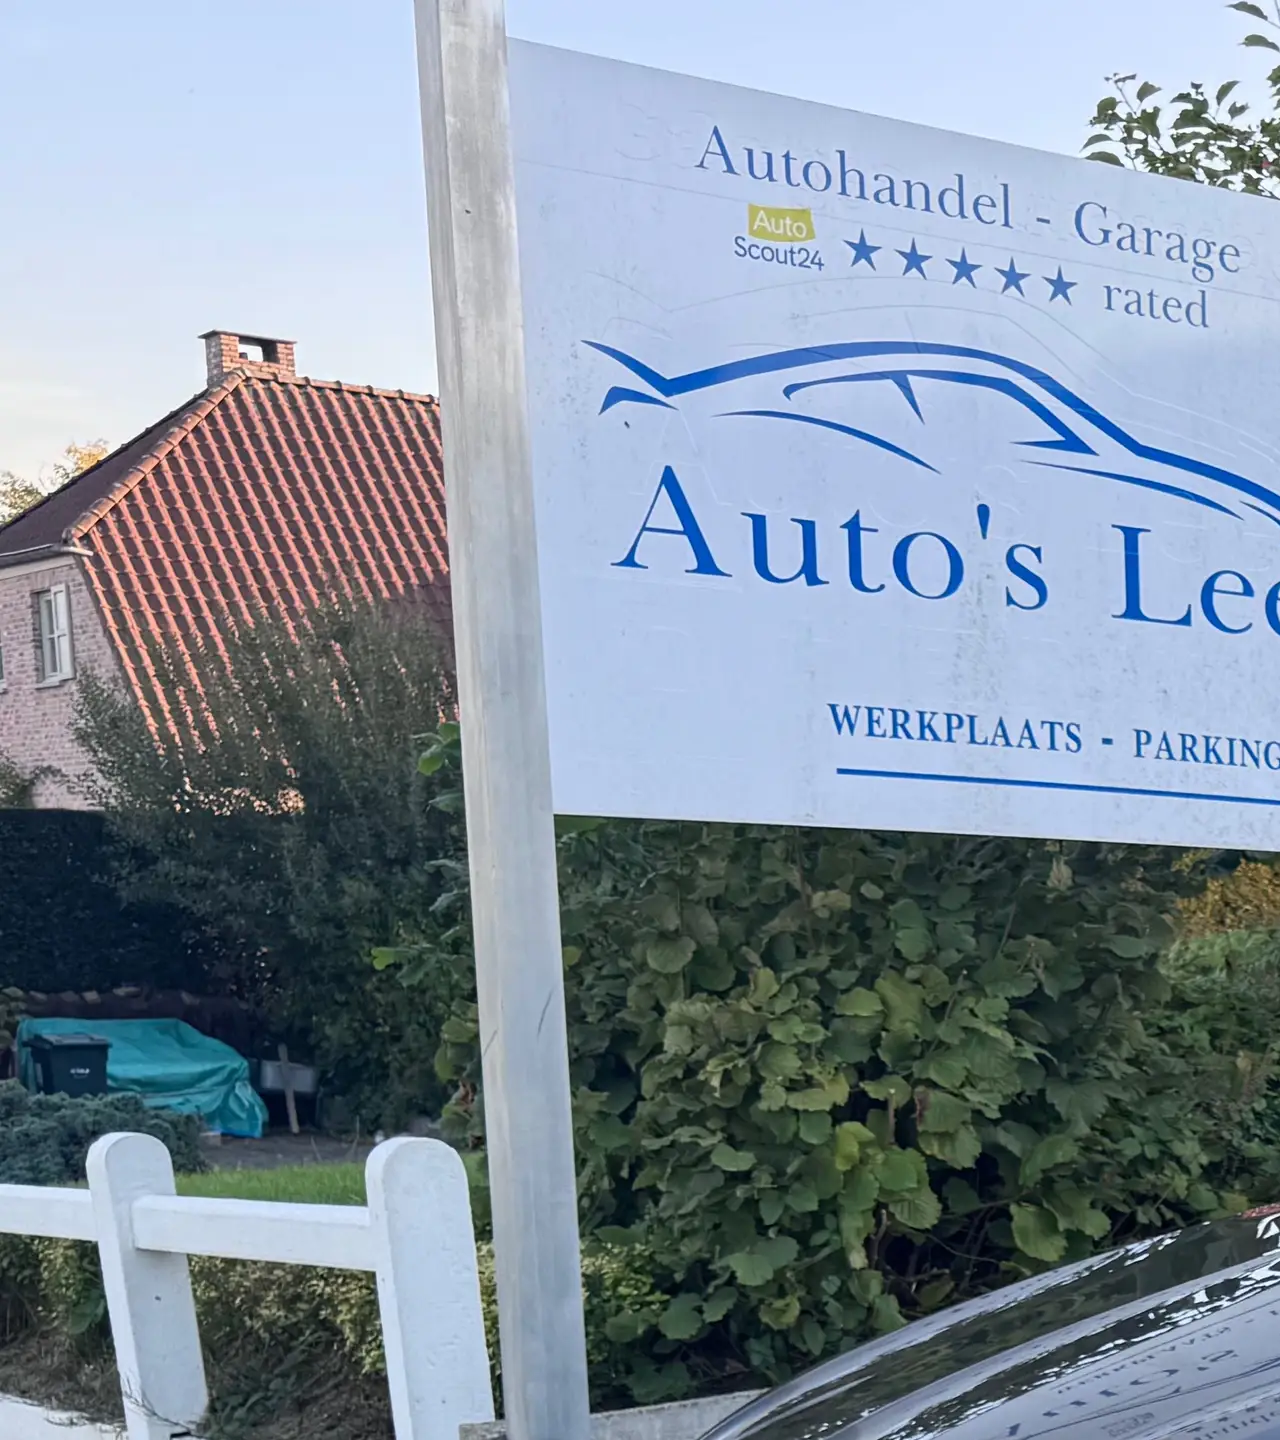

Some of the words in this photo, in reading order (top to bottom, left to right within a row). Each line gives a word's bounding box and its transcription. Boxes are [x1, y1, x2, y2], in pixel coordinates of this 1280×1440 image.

[693, 123, 1014, 231] Autohandel
[1073, 200, 1241, 283] Garage
[753, 209, 809, 240] Auto
[733, 235, 825, 272] Scout24
[1102, 285, 1209, 329] rated
[610, 464, 1049, 611] Auto's
[826, 702, 1082, 754] WERKPLAATS
